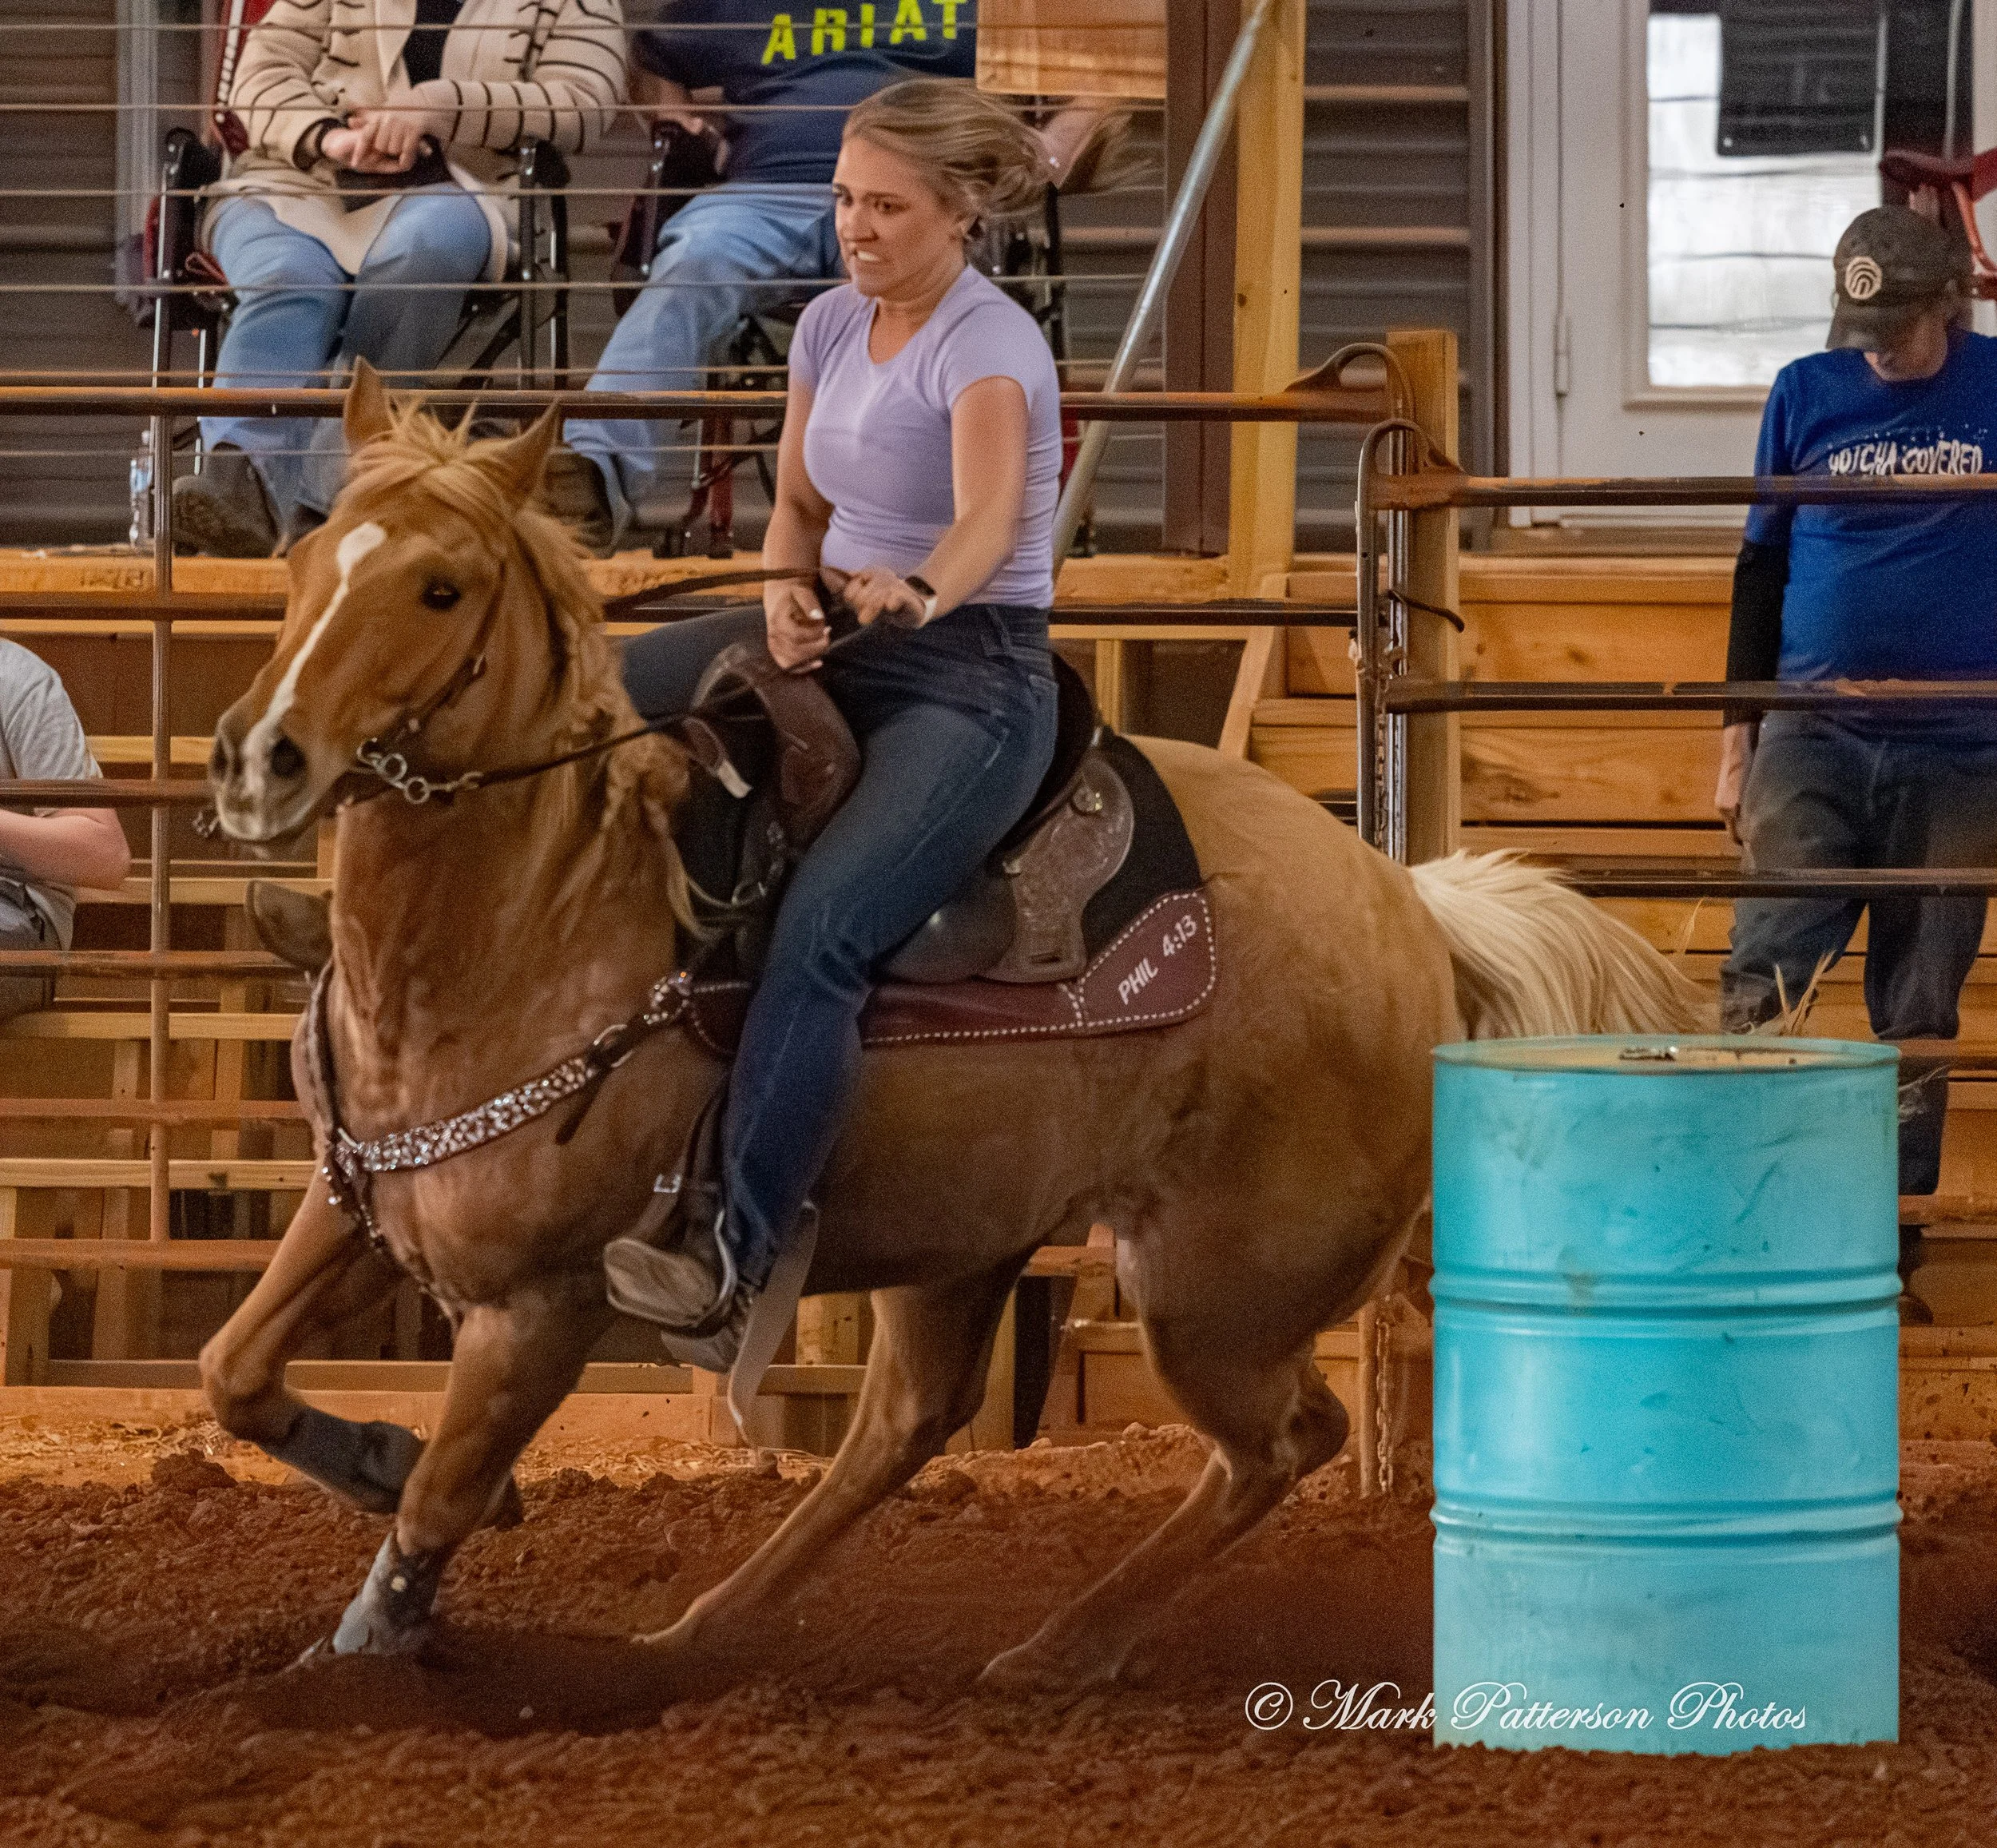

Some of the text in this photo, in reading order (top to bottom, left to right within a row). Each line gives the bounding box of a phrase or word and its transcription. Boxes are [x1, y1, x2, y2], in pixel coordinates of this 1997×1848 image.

[761, 0, 968, 65] ARIAT
[1902, 439, 1983, 475] COVERED
[1118, 914, 1197, 1006] PHIL 4:13
